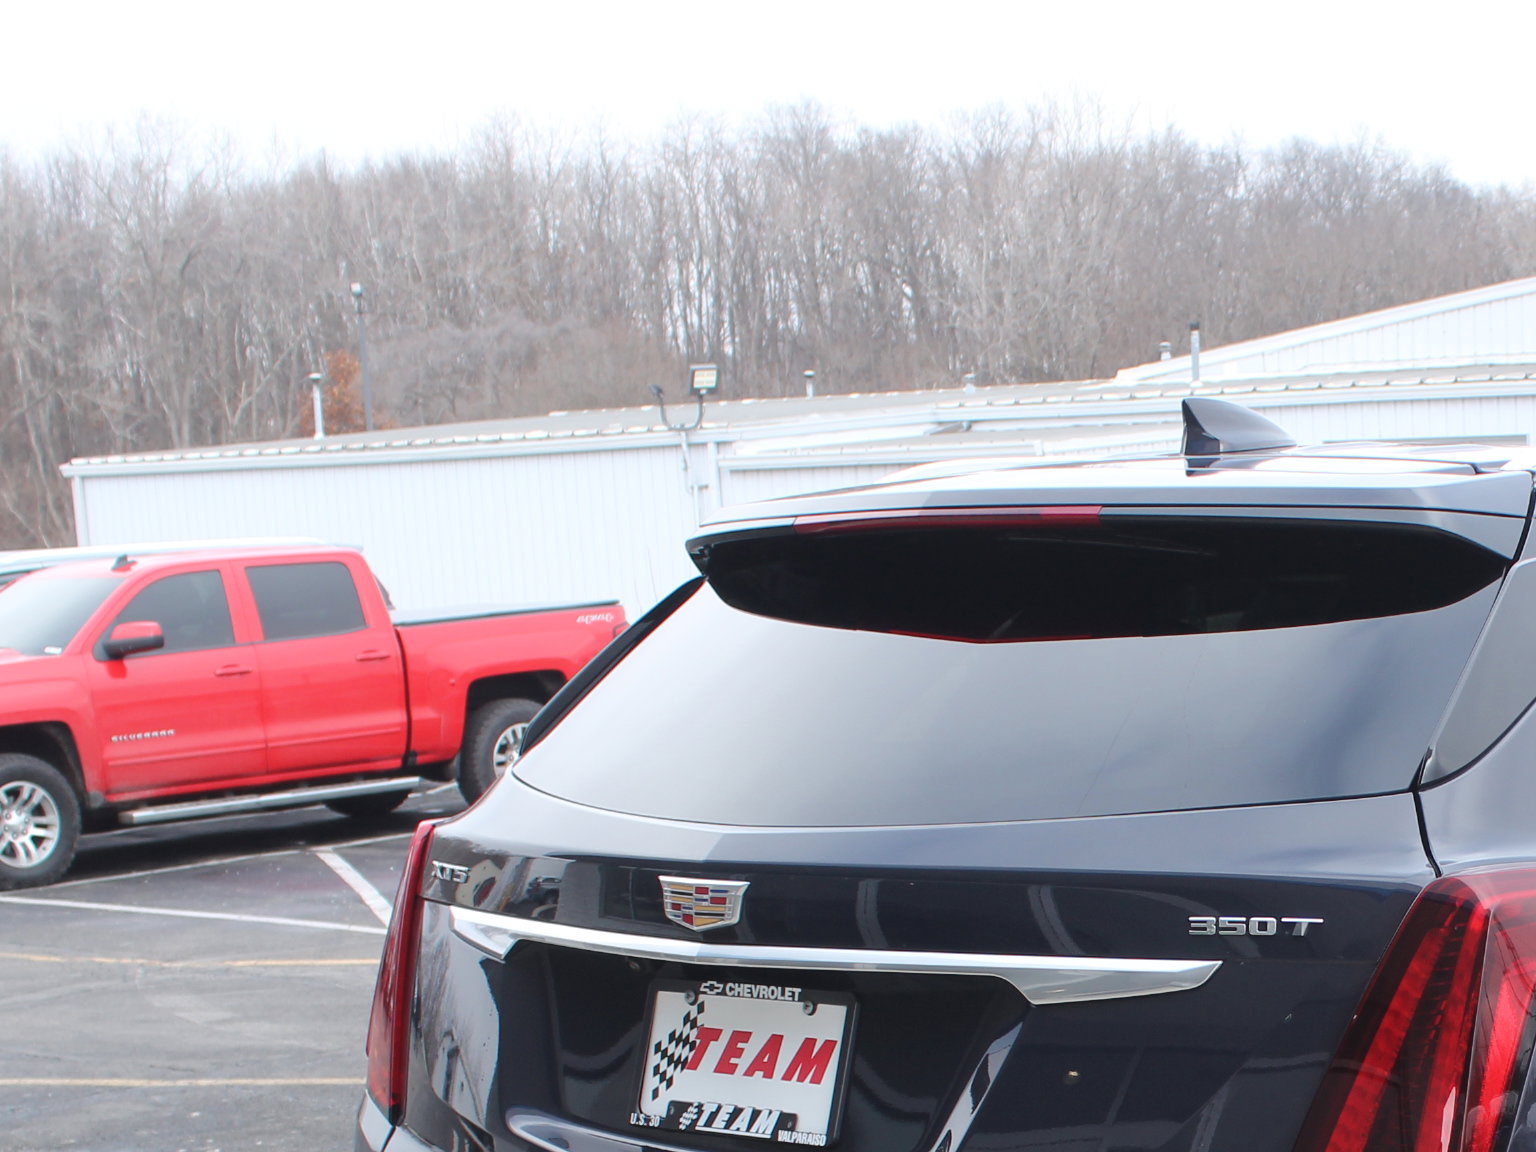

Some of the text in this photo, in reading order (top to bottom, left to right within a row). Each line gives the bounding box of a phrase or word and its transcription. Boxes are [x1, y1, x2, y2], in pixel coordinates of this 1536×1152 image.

[1188, 916, 1324, 936] 350T
[725, 982, 802, 1001] CHEVROLET
[684, 1026, 837, 1085] TEAM
[630, 1112, 660, 1128] U.S. 30
[696, 1102, 782, 1135] TEAM
[777, 1130, 826, 1147] VALPARAISO
